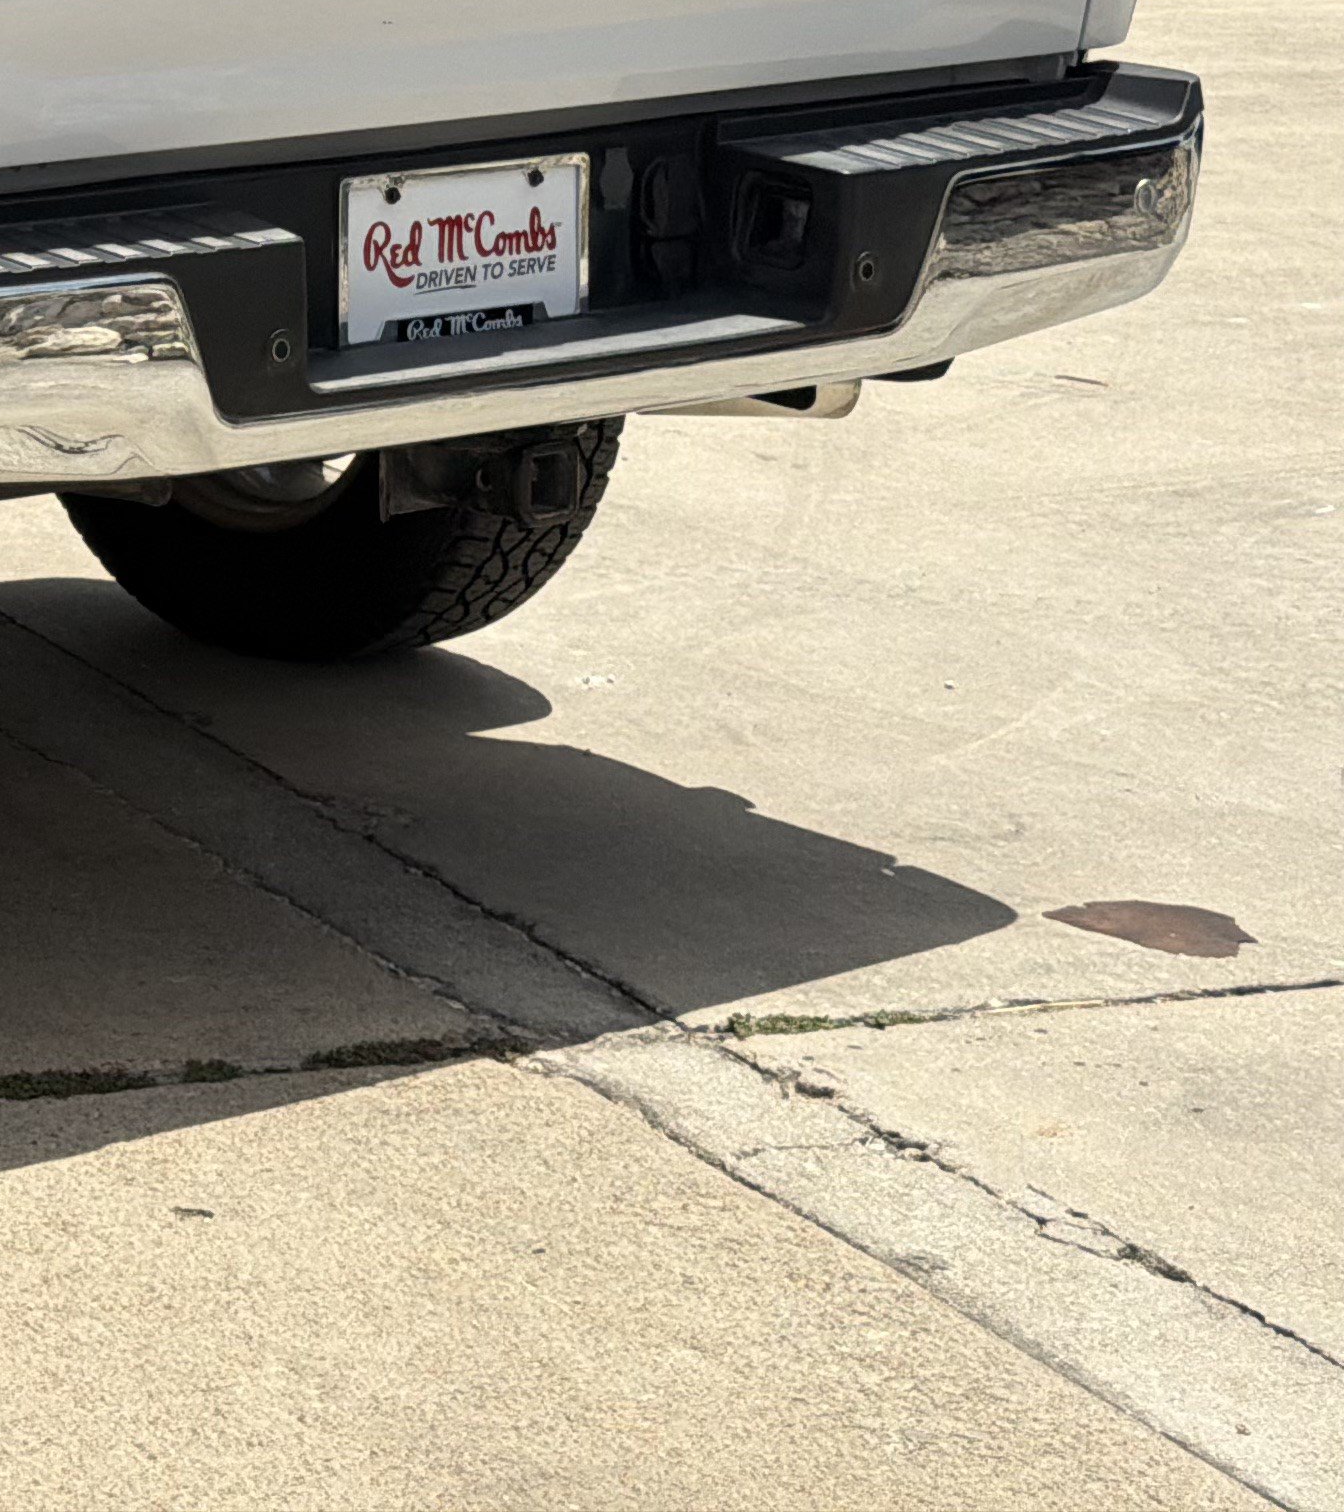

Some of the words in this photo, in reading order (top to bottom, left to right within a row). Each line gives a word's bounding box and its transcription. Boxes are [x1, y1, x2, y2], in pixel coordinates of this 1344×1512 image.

[364, 220, 422, 288] Red
[427, 206, 557, 264] McCombs
[415, 266, 477, 290] DRIVEN
[482, 263, 504, 281] TO
[508, 254, 557, 278] SERVE
[406, 319, 443, 341] Red
